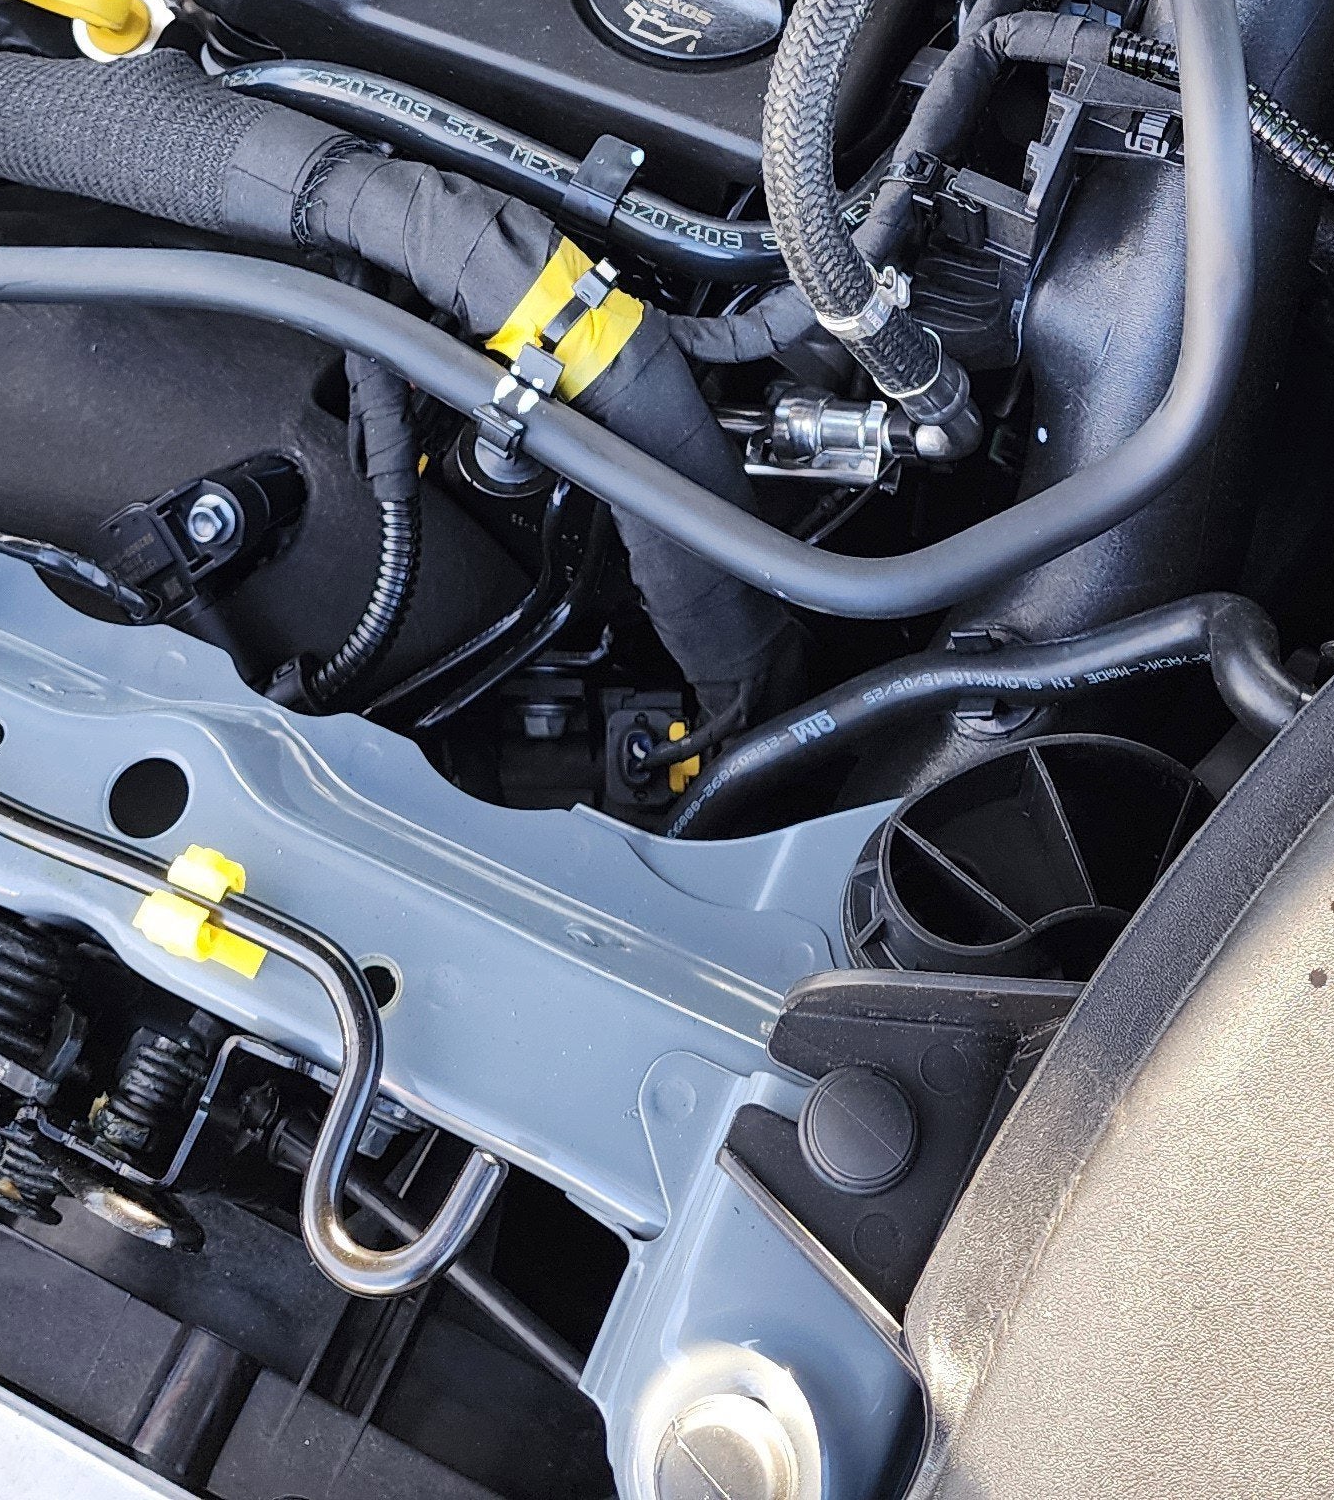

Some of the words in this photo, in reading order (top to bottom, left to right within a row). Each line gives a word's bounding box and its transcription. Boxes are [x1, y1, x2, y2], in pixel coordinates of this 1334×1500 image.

[298, 68, 433, 123] 25207409
[509, 143, 564, 181] MEX
[950, 671, 1043, 691] SLOVAKIA
